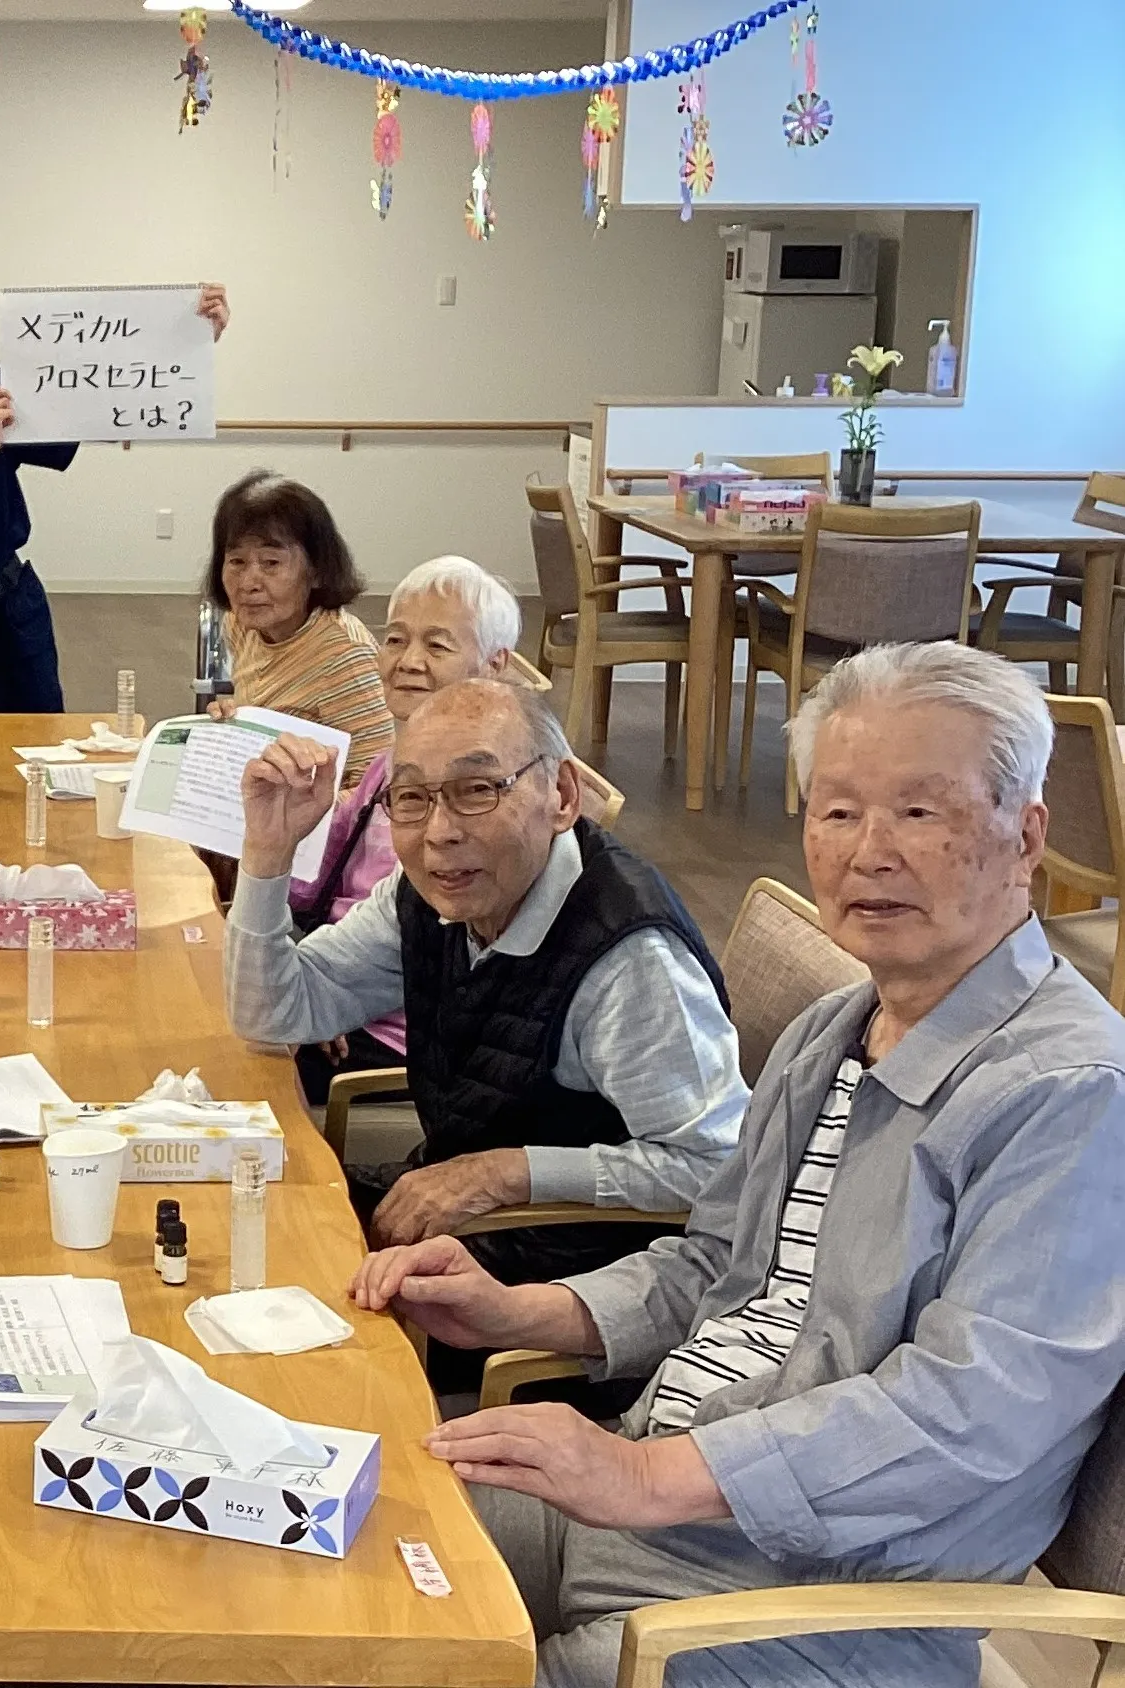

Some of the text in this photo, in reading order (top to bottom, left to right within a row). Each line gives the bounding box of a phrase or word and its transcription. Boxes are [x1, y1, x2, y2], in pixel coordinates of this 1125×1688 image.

[17, 311, 141, 344] メディカル
[35, 361, 196, 393] アロマセラピー
[113, 400, 193, 430] とは？
[225, 1499, 264, 1518] Hoxy
